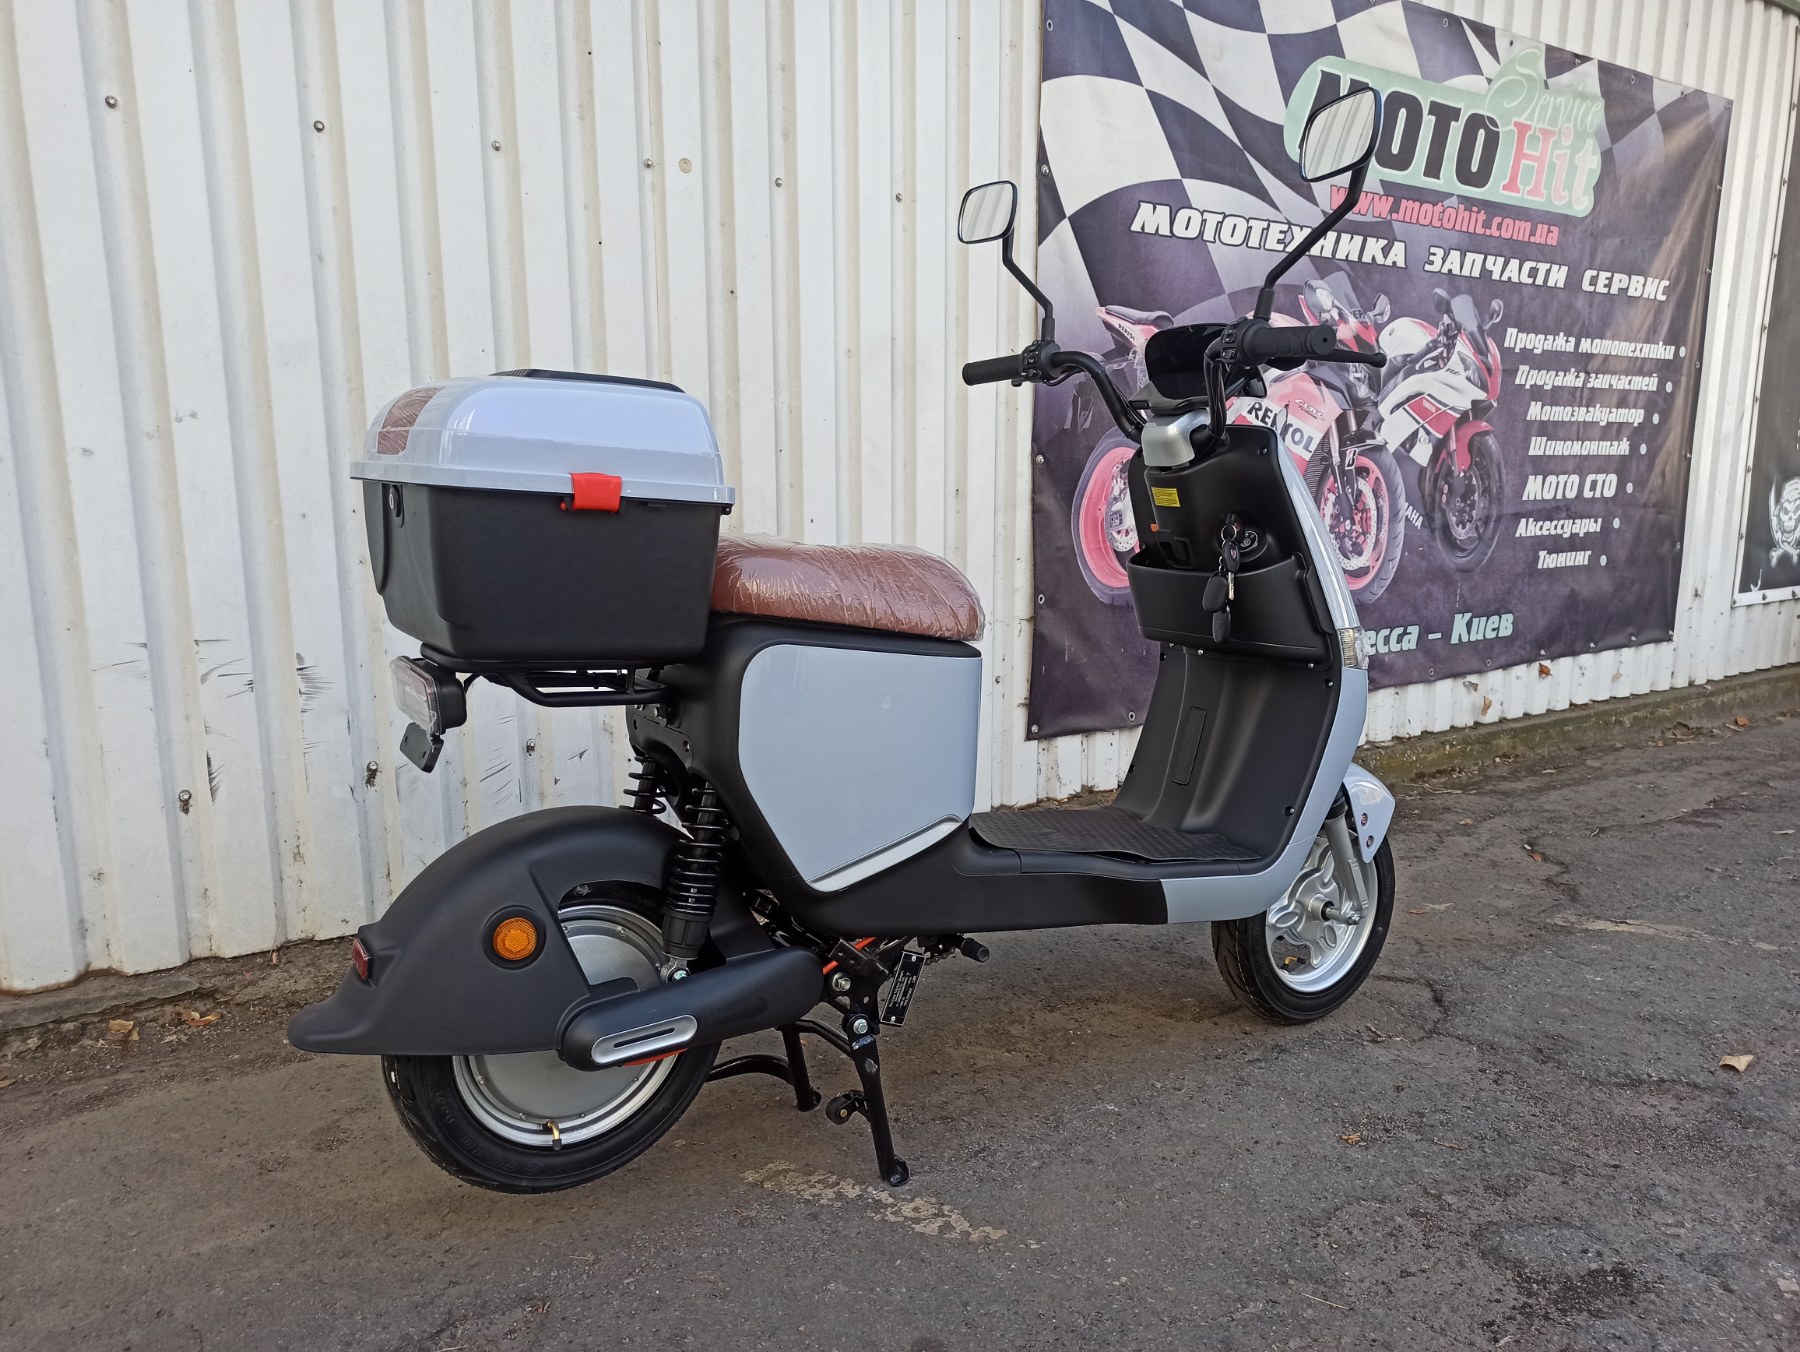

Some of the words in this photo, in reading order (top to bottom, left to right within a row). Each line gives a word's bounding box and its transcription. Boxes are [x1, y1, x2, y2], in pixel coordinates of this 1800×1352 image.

[1485, 47, 1602, 134] Service
[1501, 119, 1598, 210] Hit
[1130, 201, 1407, 268] МОТОТЕХНИКА
[1424, 246, 1569, 289] ЗАПЧАСТИ
[1581, 269, 1671, 302] СЕРВИС
[1503, 327, 1576, 355] Продажа
[1578, 337, 1676, 360] мототехники
[1514, 364, 1586, 390] Продажа
[1586, 373, 1659, 392] запчастей
[1528, 436, 1630, 456] Шиномонтаж
[1522, 474, 1580, 501] МОТО
[1582, 473, 1618, 499] СТО
[1515, 518, 1602, 538] Аксессуары
[1537, 550, 1592, 569] Тюнинг
[1450, 612, 1515, 645] Киев
